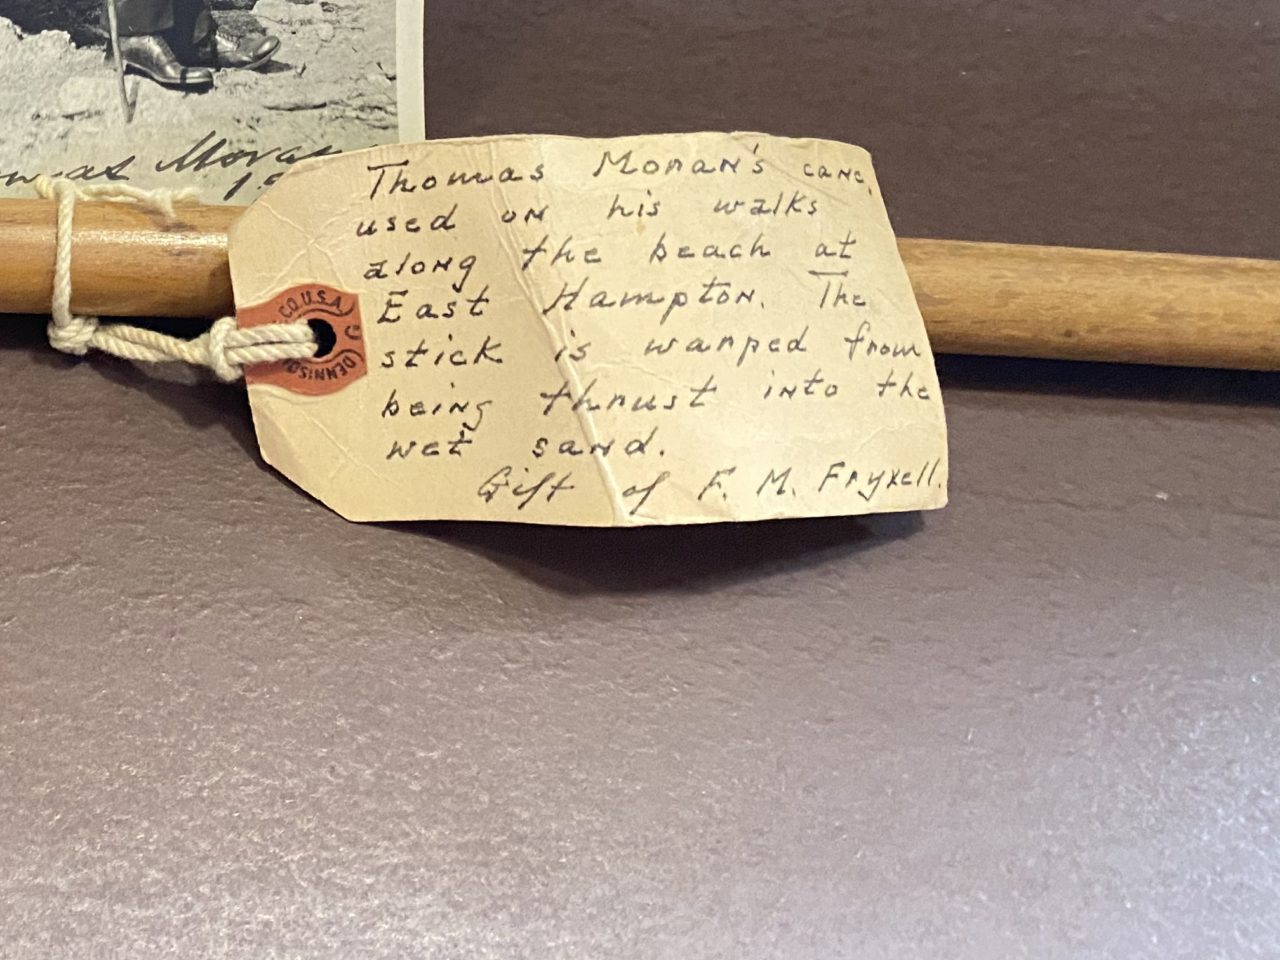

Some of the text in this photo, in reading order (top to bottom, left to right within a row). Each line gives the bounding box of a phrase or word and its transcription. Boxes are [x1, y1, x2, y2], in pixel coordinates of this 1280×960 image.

[367, 159, 545, 200] Thomas
[592, 143, 765, 178] Moran's
[356, 189, 819, 237] used on his walks
[363, 229, 857, 294] along the beach at
[377, 270, 867, 326] East Hampton. The
[379, 320, 922, 369] stick is warped from
[381, 369, 932, 432] being thrust into the
[386, 426, 665, 460] wet sand.
[477, 466, 575, 510] Gift
[621, 471, 672, 516] of
[697, 466, 737, 501] F.
[756, 467, 797, 498] M.
